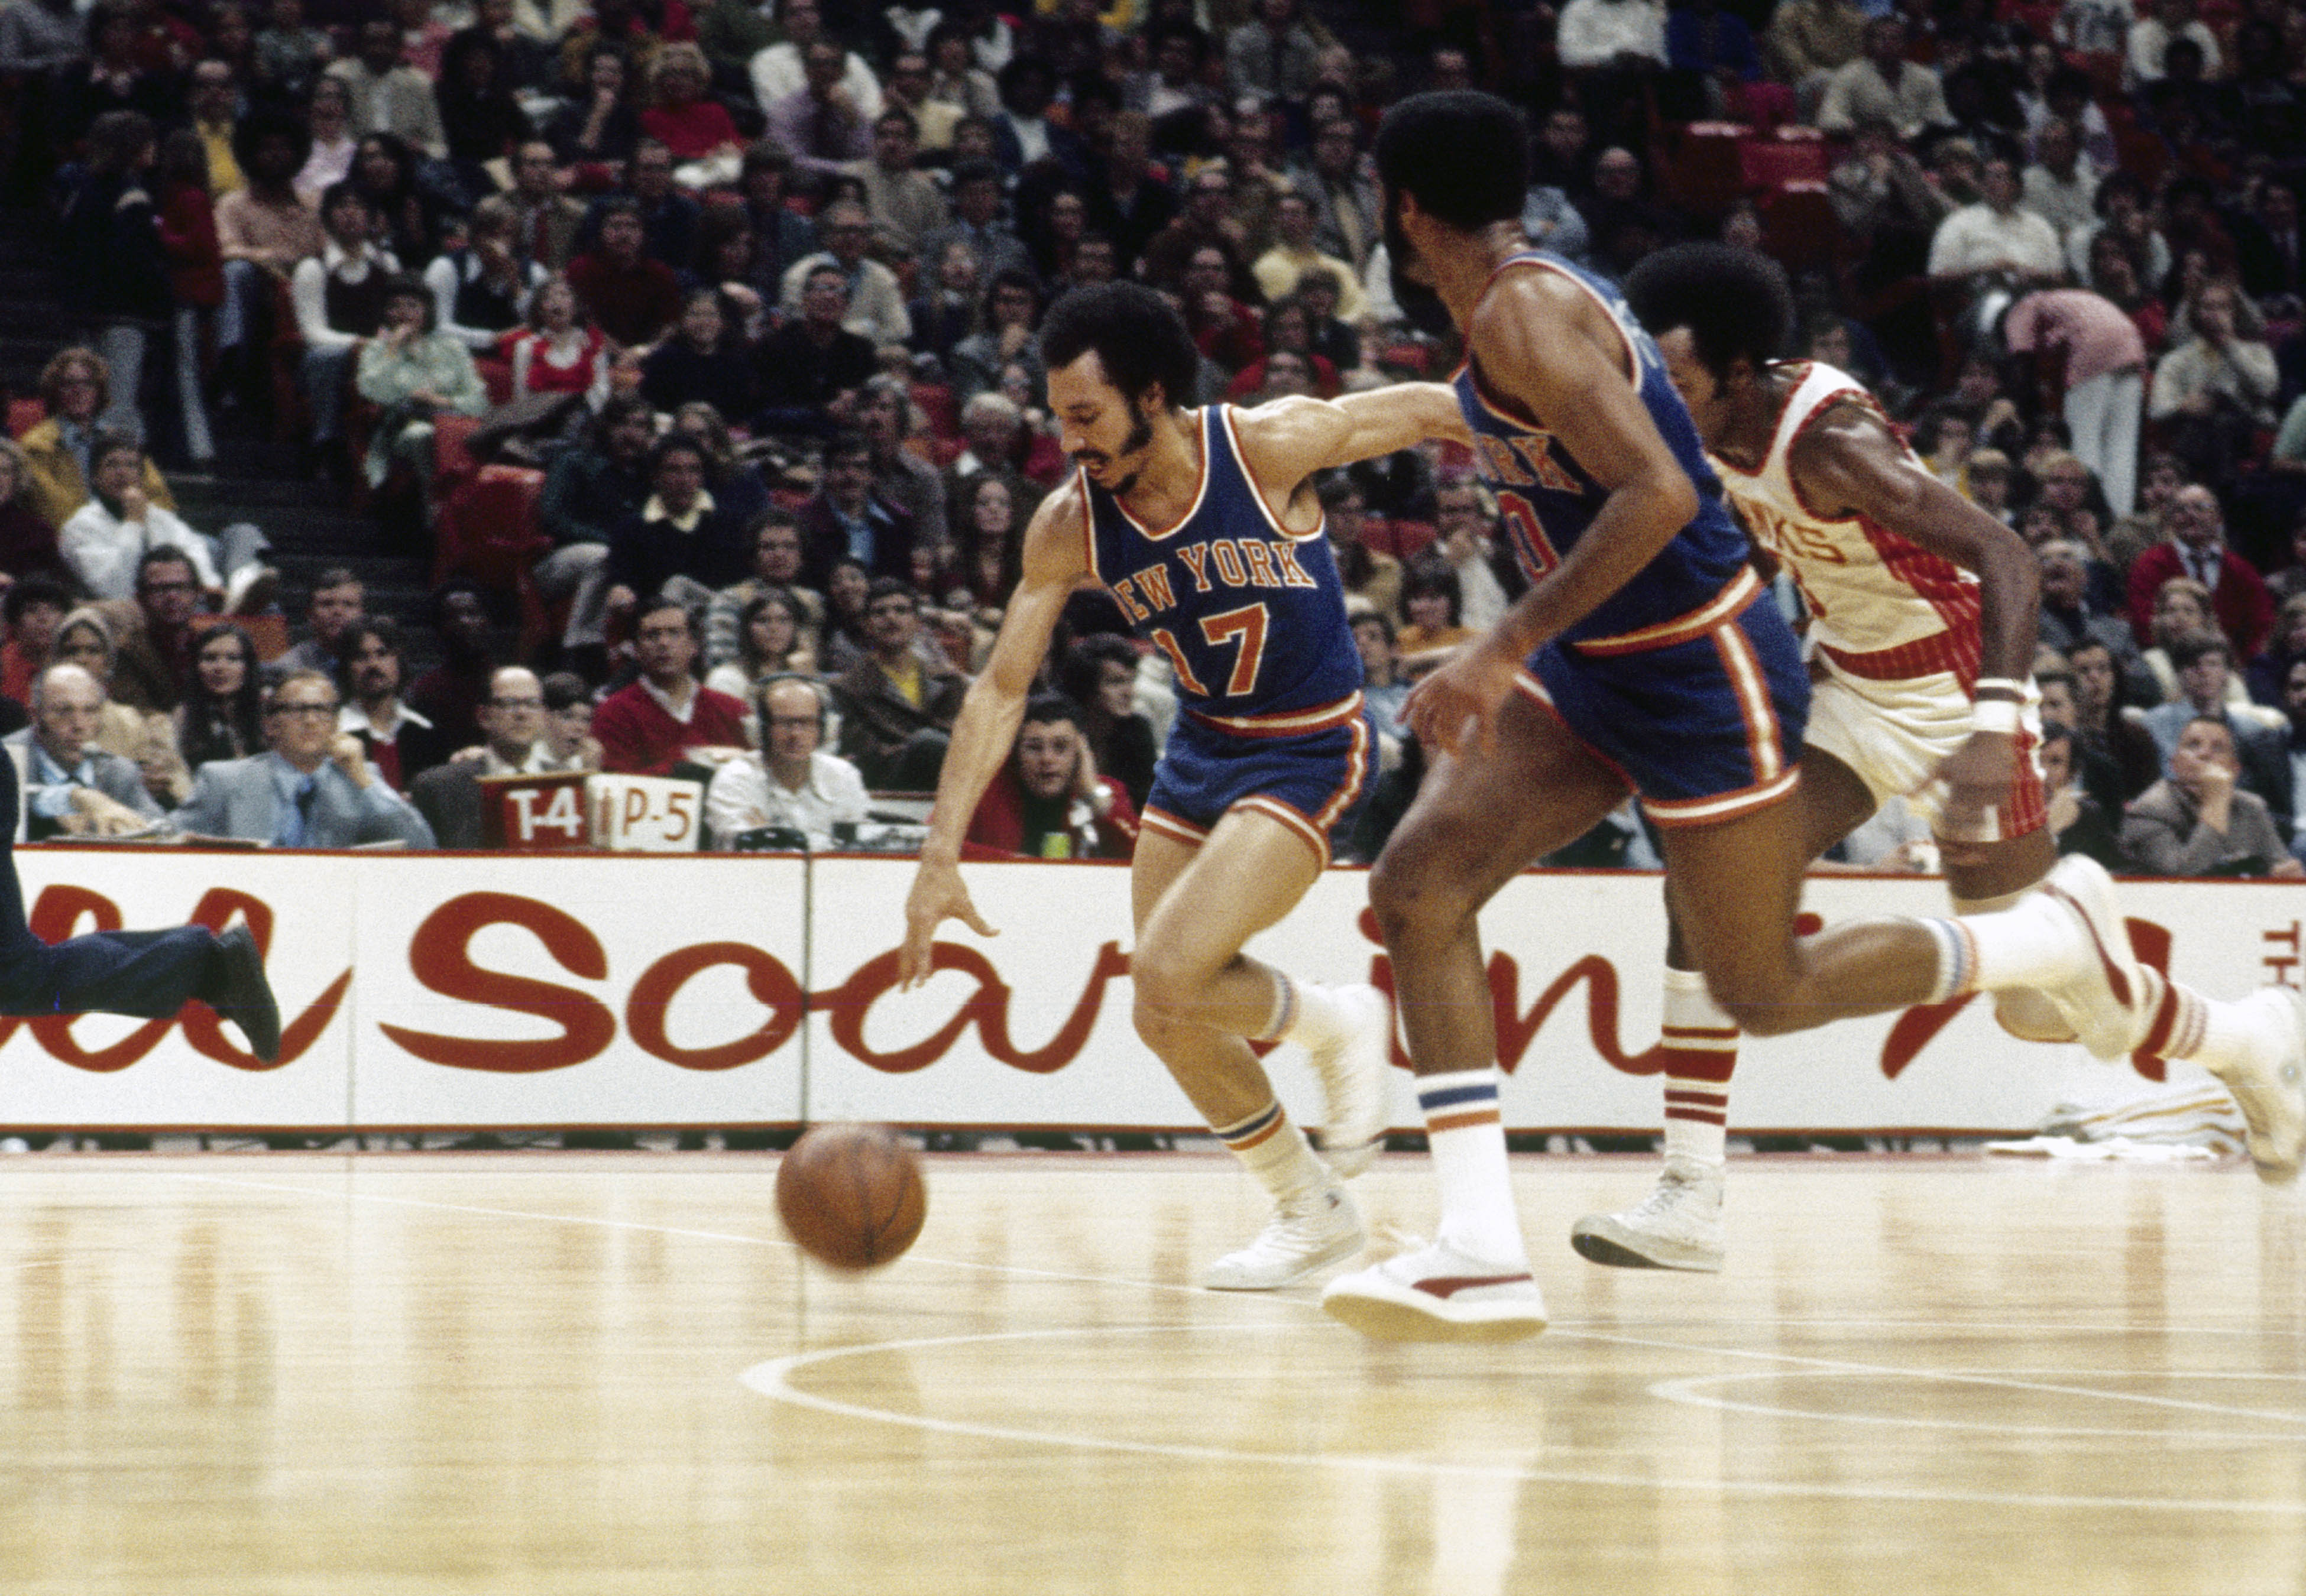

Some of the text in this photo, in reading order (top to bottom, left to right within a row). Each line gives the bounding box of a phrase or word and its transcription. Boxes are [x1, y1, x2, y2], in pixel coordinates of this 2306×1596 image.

[1175, 538, 1319, 592] YORK
[1150, 601, 1271, 697] 17
[506, 786, 582, 841] T-4
[622, 786, 693, 841] P-5
